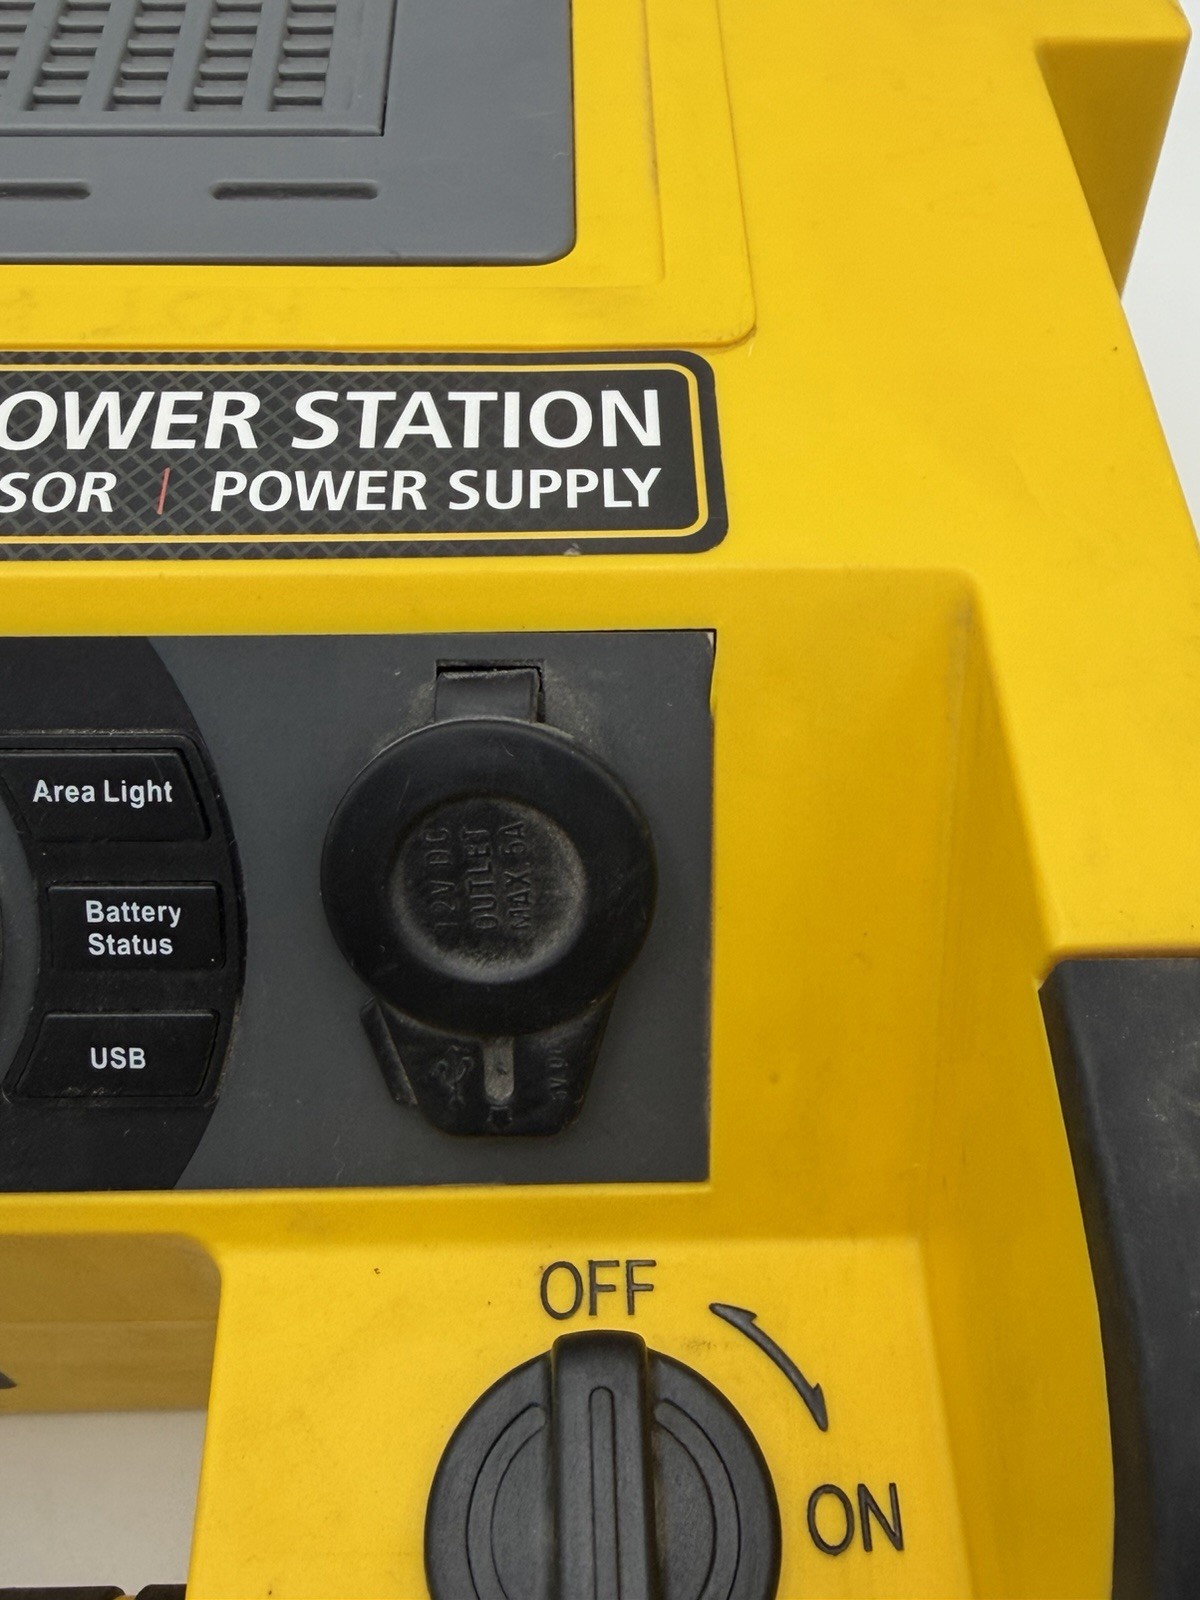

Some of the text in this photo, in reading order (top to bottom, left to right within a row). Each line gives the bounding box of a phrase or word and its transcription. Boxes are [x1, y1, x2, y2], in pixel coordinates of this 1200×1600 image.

[0, 389, 662, 451] OWER STATION
[0, 467, 662, 514] SOR POWER SUPPLY
[32, 779, 173, 809] Area Light
[424, 827, 458, 932] 12V DC
[463, 827, 499, 930] OUTLET
[85, 900, 181, 928] Battery
[88, 932, 173, 956] Status
[90, 1046, 146, 1070] USB
[540, 1259, 657, 1320] OFF
[806, 1482, 905, 1557] ON
